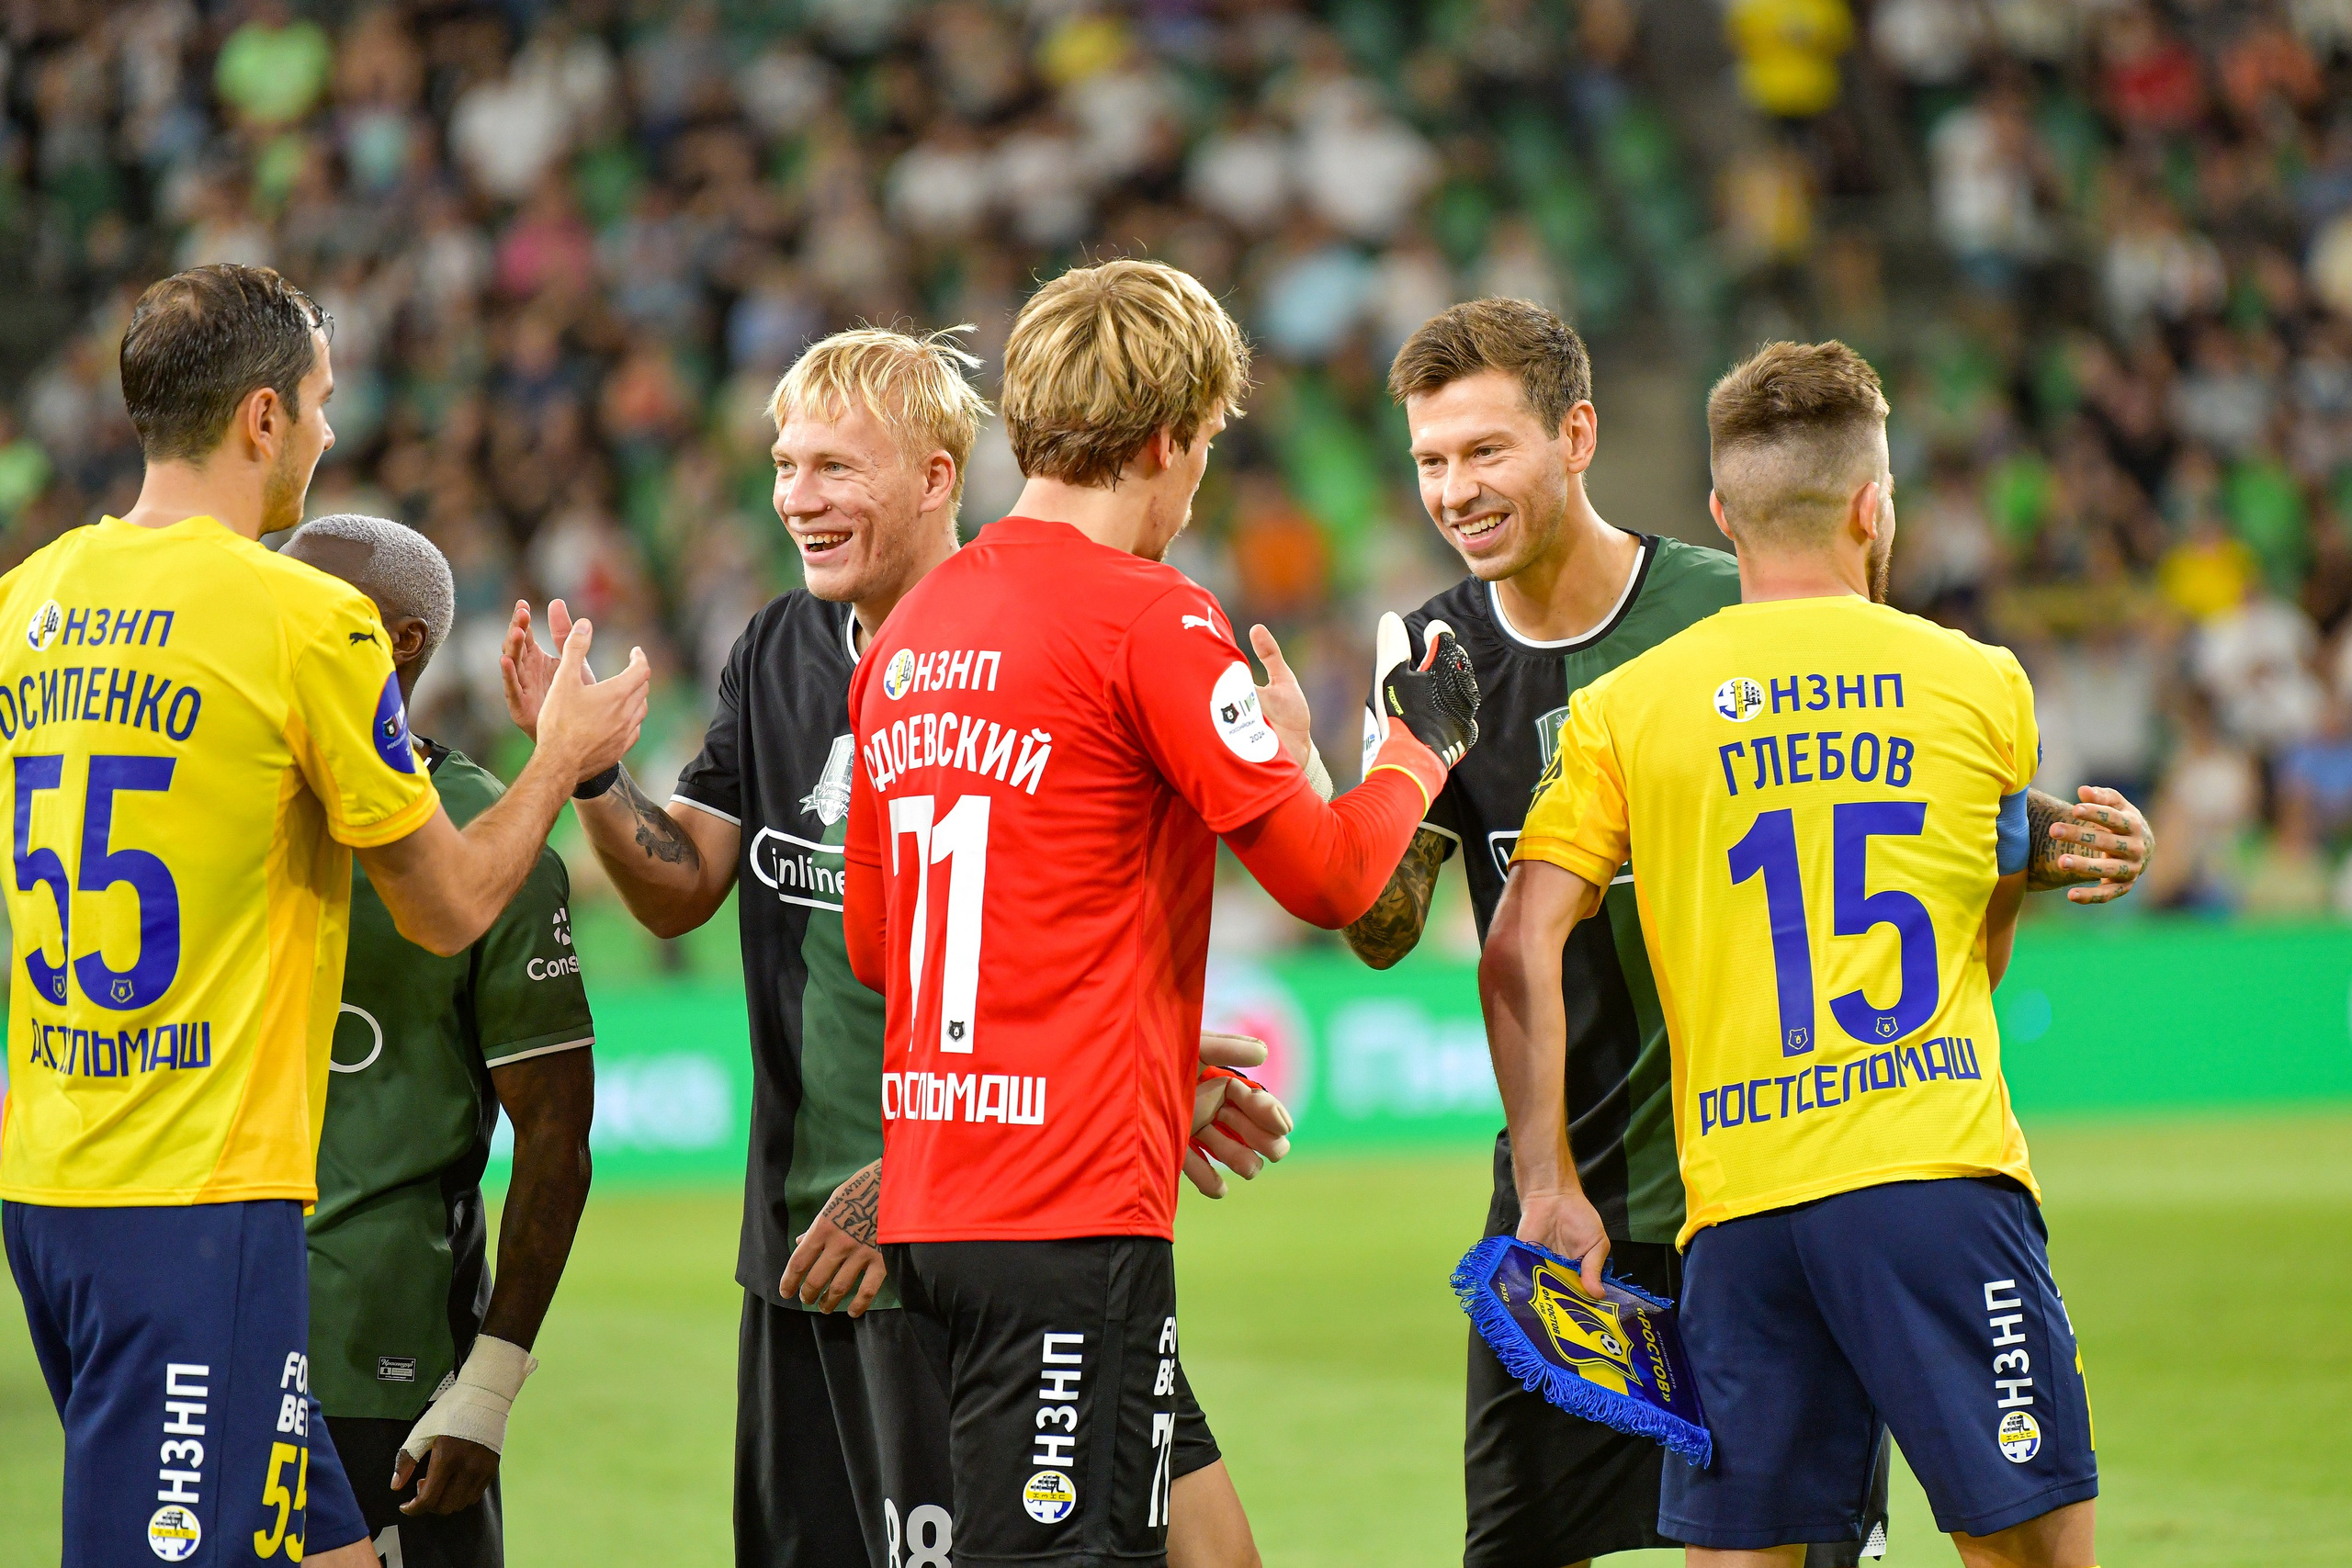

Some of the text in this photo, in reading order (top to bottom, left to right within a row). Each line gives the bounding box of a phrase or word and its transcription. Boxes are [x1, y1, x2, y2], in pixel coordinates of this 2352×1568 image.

[62, 608, 175, 647] НЗНП
[0, 667, 201, 741] ОСИПЕНКО
[913, 650, 1001, 693] НЗНП
[1387, 685, 1404, 716] PREDATOR
[1770, 673, 1904, 714] НЗНП
[1719, 731, 1915, 796] ГЛЕБОВ
[14, 754, 180, 1010] 55
[888, 795, 991, 1054] 71
[1727, 801, 1939, 1058] 15
[526, 953, 580, 981] Cons
[1543, 1289, 1560, 1335] ФК РОСТОВ
[1984, 1280, 2034, 1409] НЗНП
[1636, 1307, 1671, 1403] «РОСТОВ»
[157, 1363, 209, 1504] НЗНП
[1033, 1333, 1084, 1467] НЗНП
